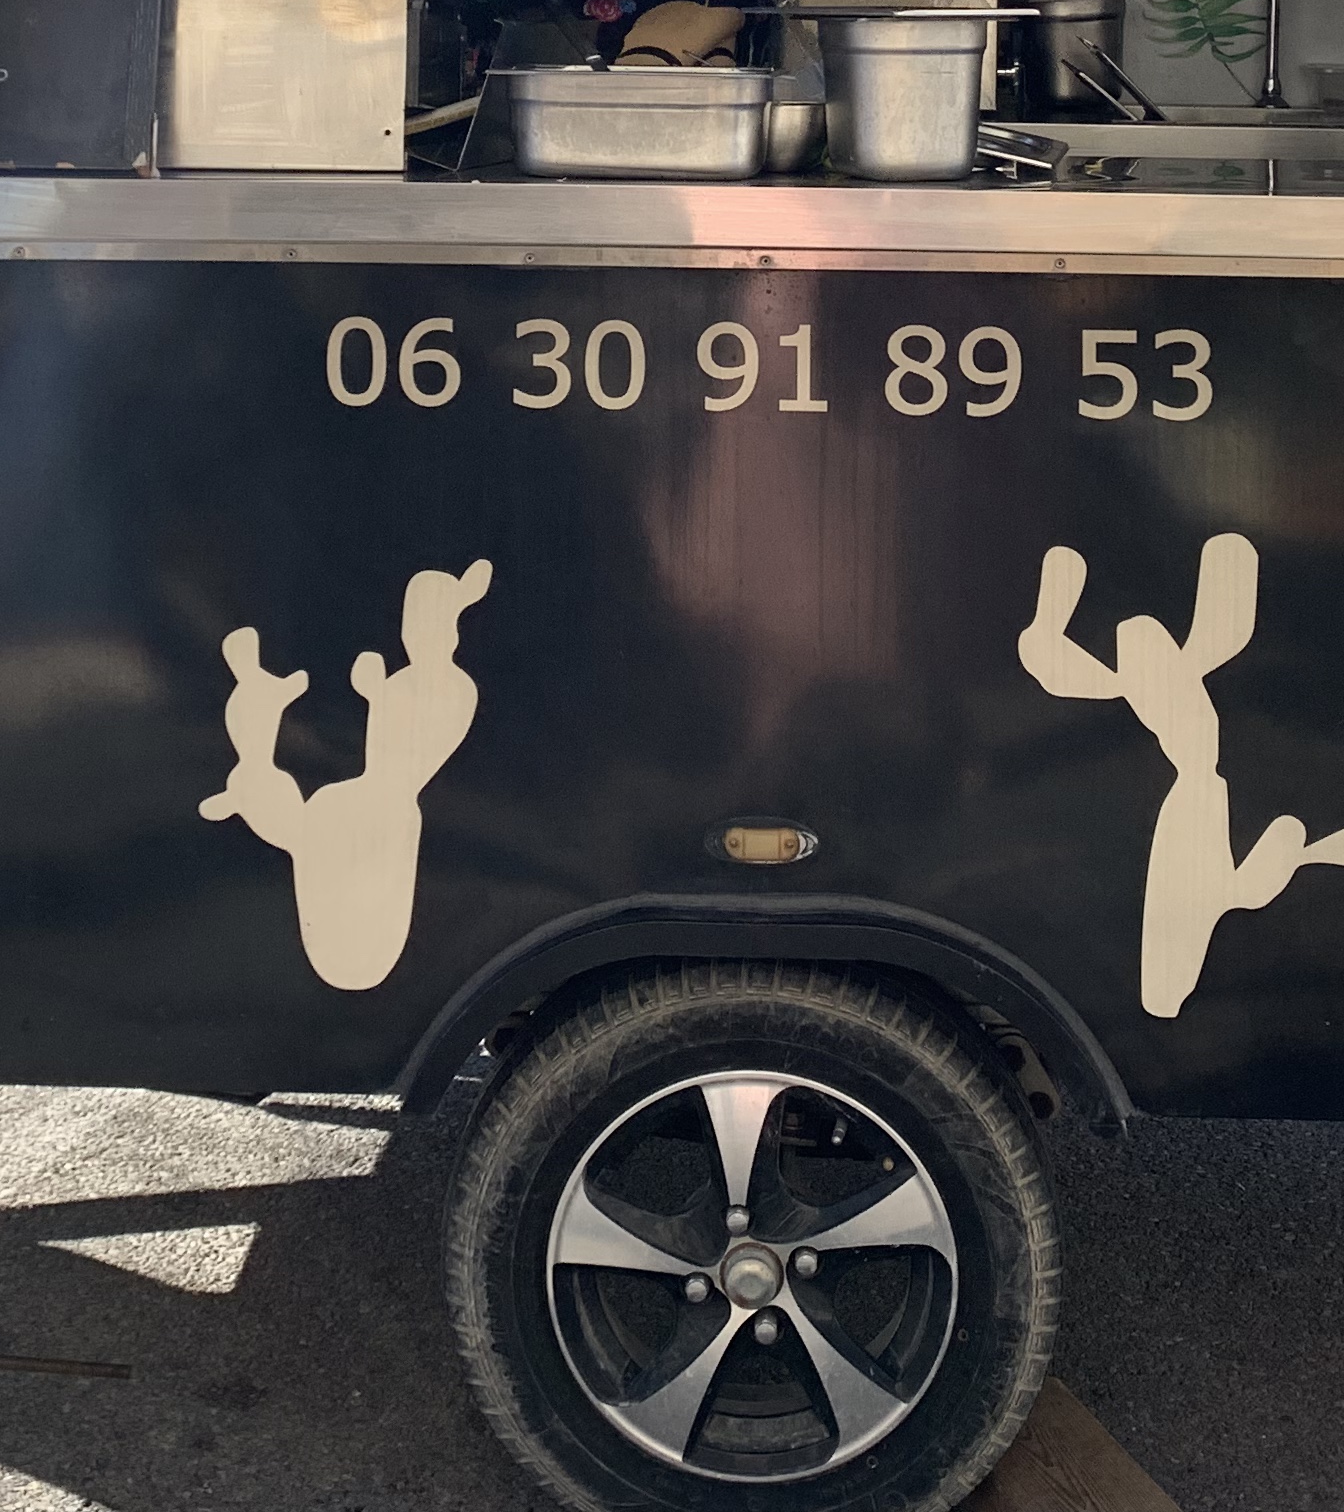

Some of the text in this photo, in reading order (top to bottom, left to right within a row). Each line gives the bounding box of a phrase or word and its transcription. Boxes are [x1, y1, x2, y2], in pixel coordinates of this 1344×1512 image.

[325, 316, 1214, 422] 06 30 91 89 53
